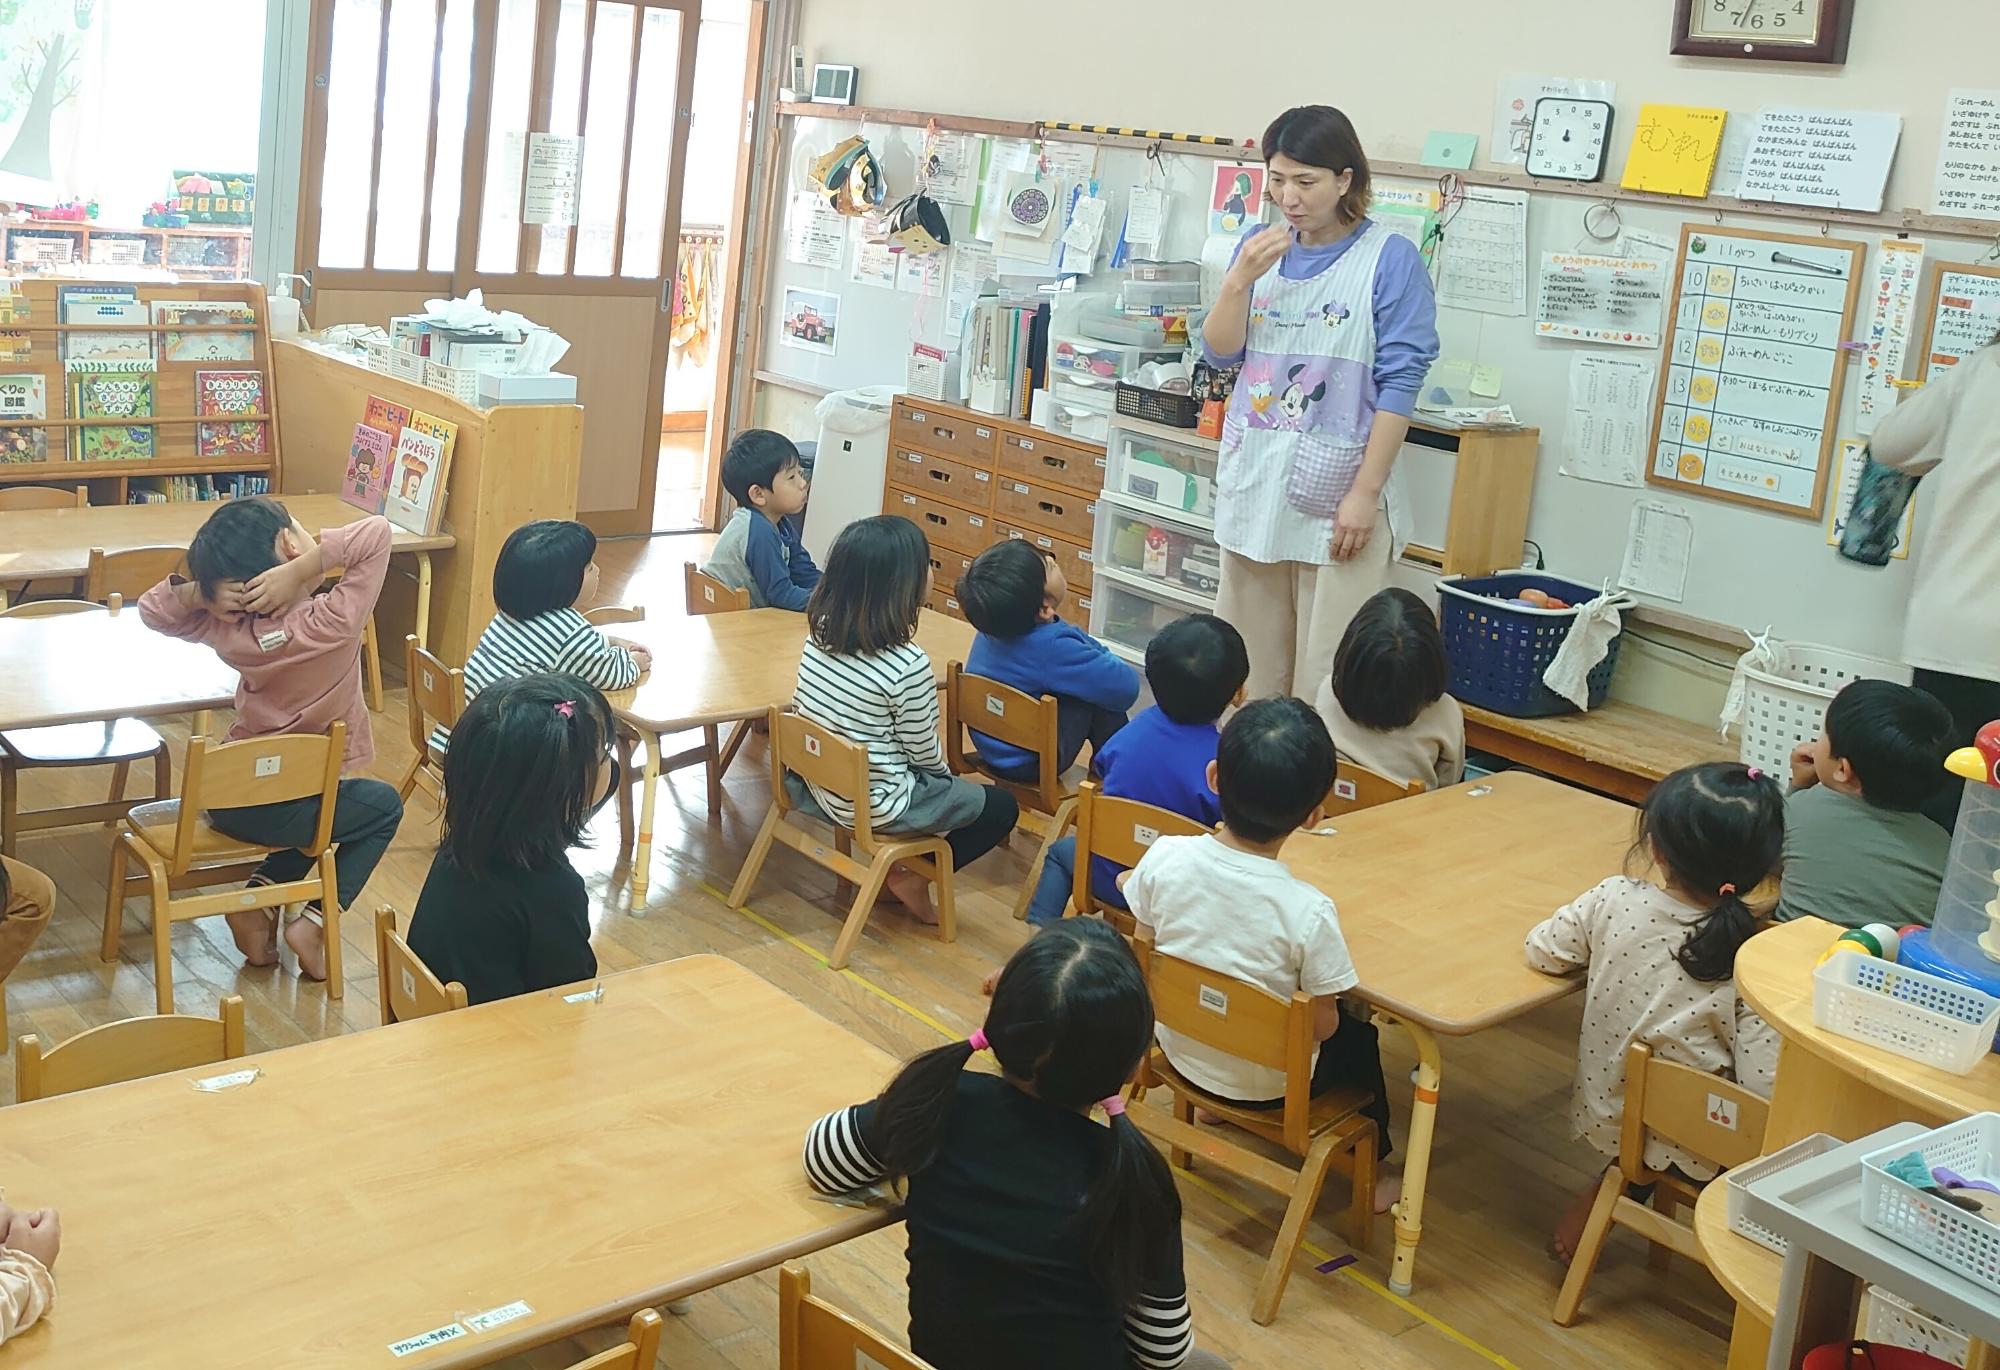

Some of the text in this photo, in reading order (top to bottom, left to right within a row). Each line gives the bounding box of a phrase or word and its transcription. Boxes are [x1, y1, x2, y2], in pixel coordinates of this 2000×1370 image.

[1714, 0, 1726, 12] 8
[1791, 1, 1804, 15] 4
[1730, 11, 1742, 26] 7
[1751, 14, 1763, 29] 6
[1773, 13, 1786, 27] 5
[1555, 108, 1560, 116] 5
[1571, 106, 1577, 114] 0
[1584, 109, 1593, 117] 55
[1953, 110, 1990, 119] いざゆけや
[1542, 118, 1550, 126] 10
[1764, 113, 1804, 123] てをたたこう
[1592, 122, 1601, 130] 50
[1761, 124, 1801, 134] てをたたこう
[1951, 121, 1980, 129] めざすは
[1535, 133, 1543, 141] 15
[1949, 131, 1983, 139] あしおとを
[1592, 137, 1601, 145] 45
[1636, 118, 1714, 163] むれ
[1757, 135, 1808, 147] なかまだみんな
[1947, 141, 1989, 151] かたをくんで
[1535, 149, 1544, 157] 20
[1586, 152, 1596, 161] 40
[1543, 161, 1552, 169] 25
[1573, 163, 1582, 171] 35
[1750, 158, 1777, 167] ありさん
[1944, 161, 1986, 171] もりのなかも
[1557, 165, 1567, 174] 30
[1969, 173, 1999, 182] とかげも
[1940, 189, 1977, 199] いざゆけや
[1938, 200, 1967, 208] めざすは
[1720, 243, 1756, 259] 11がつ
[1687, 272, 1703, 287] 10
[1740, 275, 1769, 288] ちいさい
[1682, 303, 1697, 319] 11
[1678, 340, 1691, 355] 12
[1728, 345, 1793, 366] ぶれーめん ごっこ
[95, 382, 139, 391] こんちゅう
[208, 380, 257, 390] きょうりゅう
[1673, 377, 1686, 394] 13
[100, 393, 135, 402] さがしえ
[216, 391, 249, 400] さがしえ
[4, 396, 26, 407] 図鑑
[221, 401, 246, 411] ずかん
[105, 404, 132, 413] ずかん
[1668, 415, 1681, 433] 14
[1717, 415, 1748, 427] くっきんぐ
[401, 437, 436, 461] パンどろぼう
[1661, 452, 1675, 469] 15
[1720, 467, 1758, 482] そとあそび
